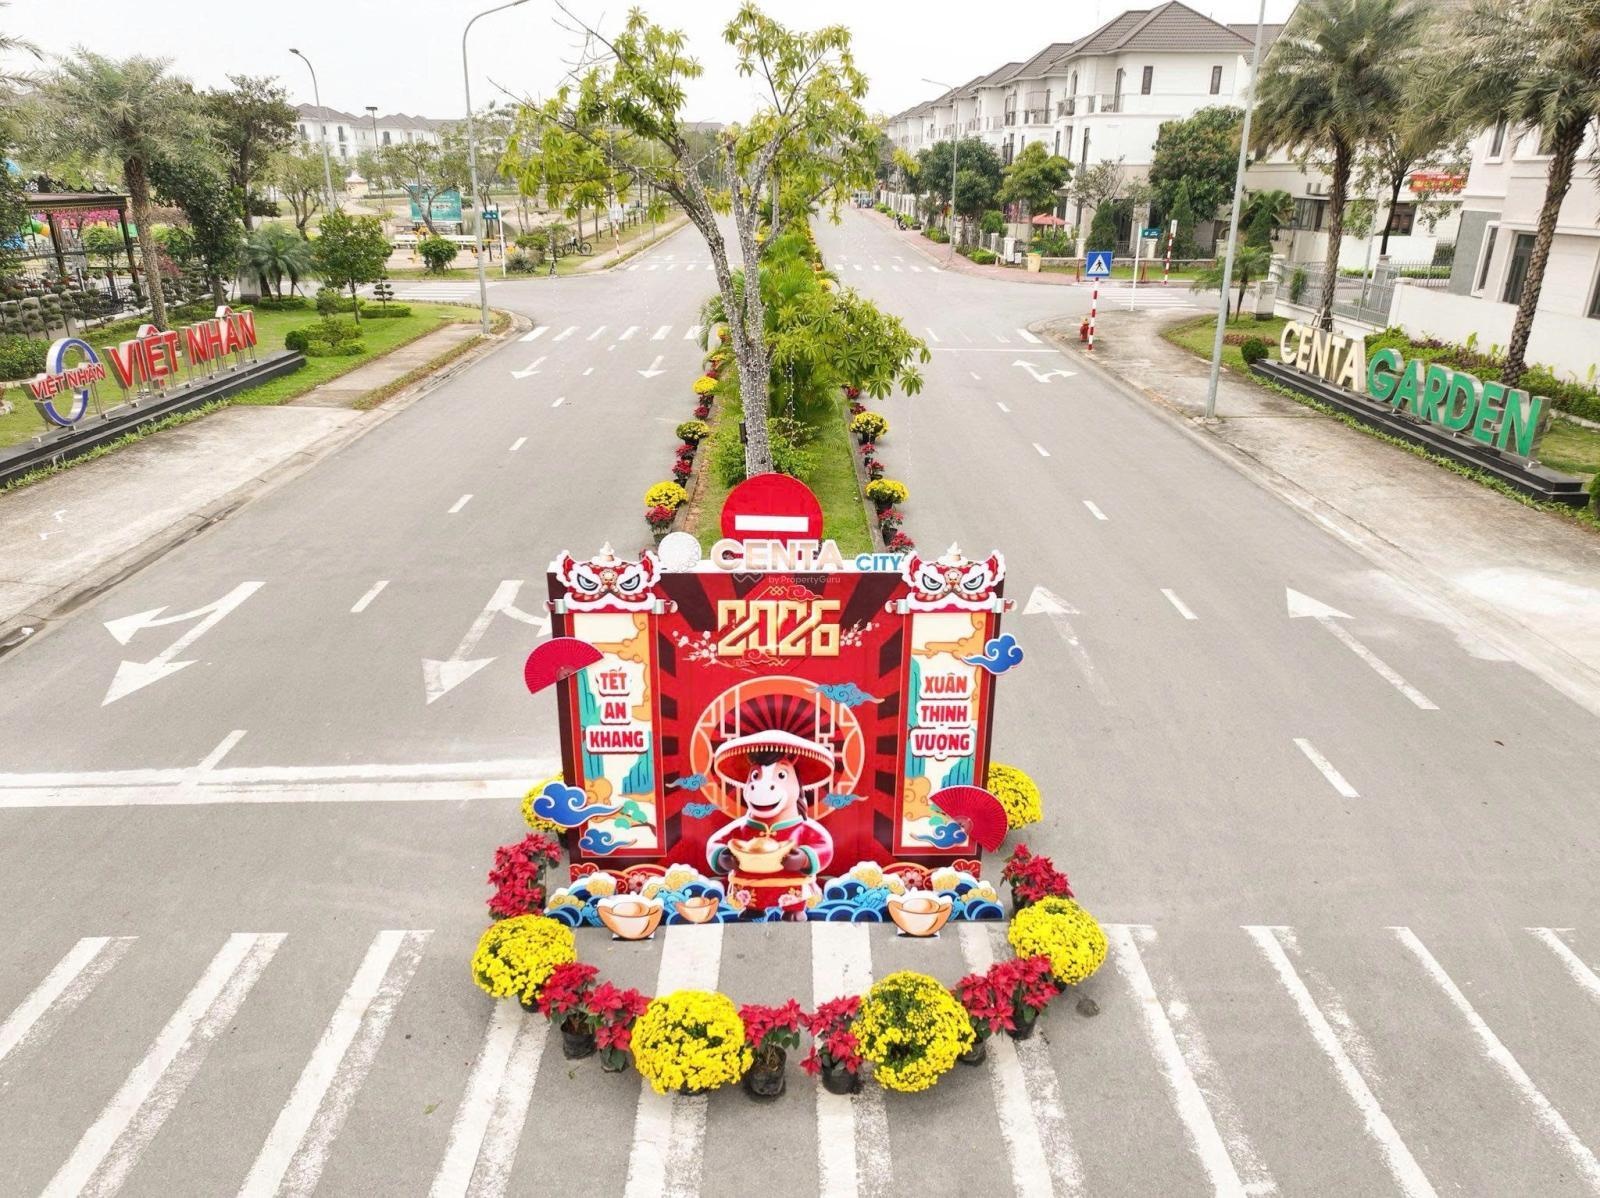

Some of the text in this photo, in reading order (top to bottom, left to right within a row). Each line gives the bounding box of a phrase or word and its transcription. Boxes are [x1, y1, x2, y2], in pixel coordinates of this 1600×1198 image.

[108, 305, 258, 390] VIỆT NHÂN
[30, 363, 106, 400] VIỆT NHÂN
[1280, 320, 1545, 458] CENTA GARDEN
[711, 538, 901, 571] CENTA CITY
[718, 599, 841, 657] 2026
[600, 666, 627, 690] TẾT
[924, 672, 968, 693] XUÂN
[604, 702, 627, 719] AN
[920, 705, 968, 726] THỊNH
[589, 730, 644, 748] KHANG
